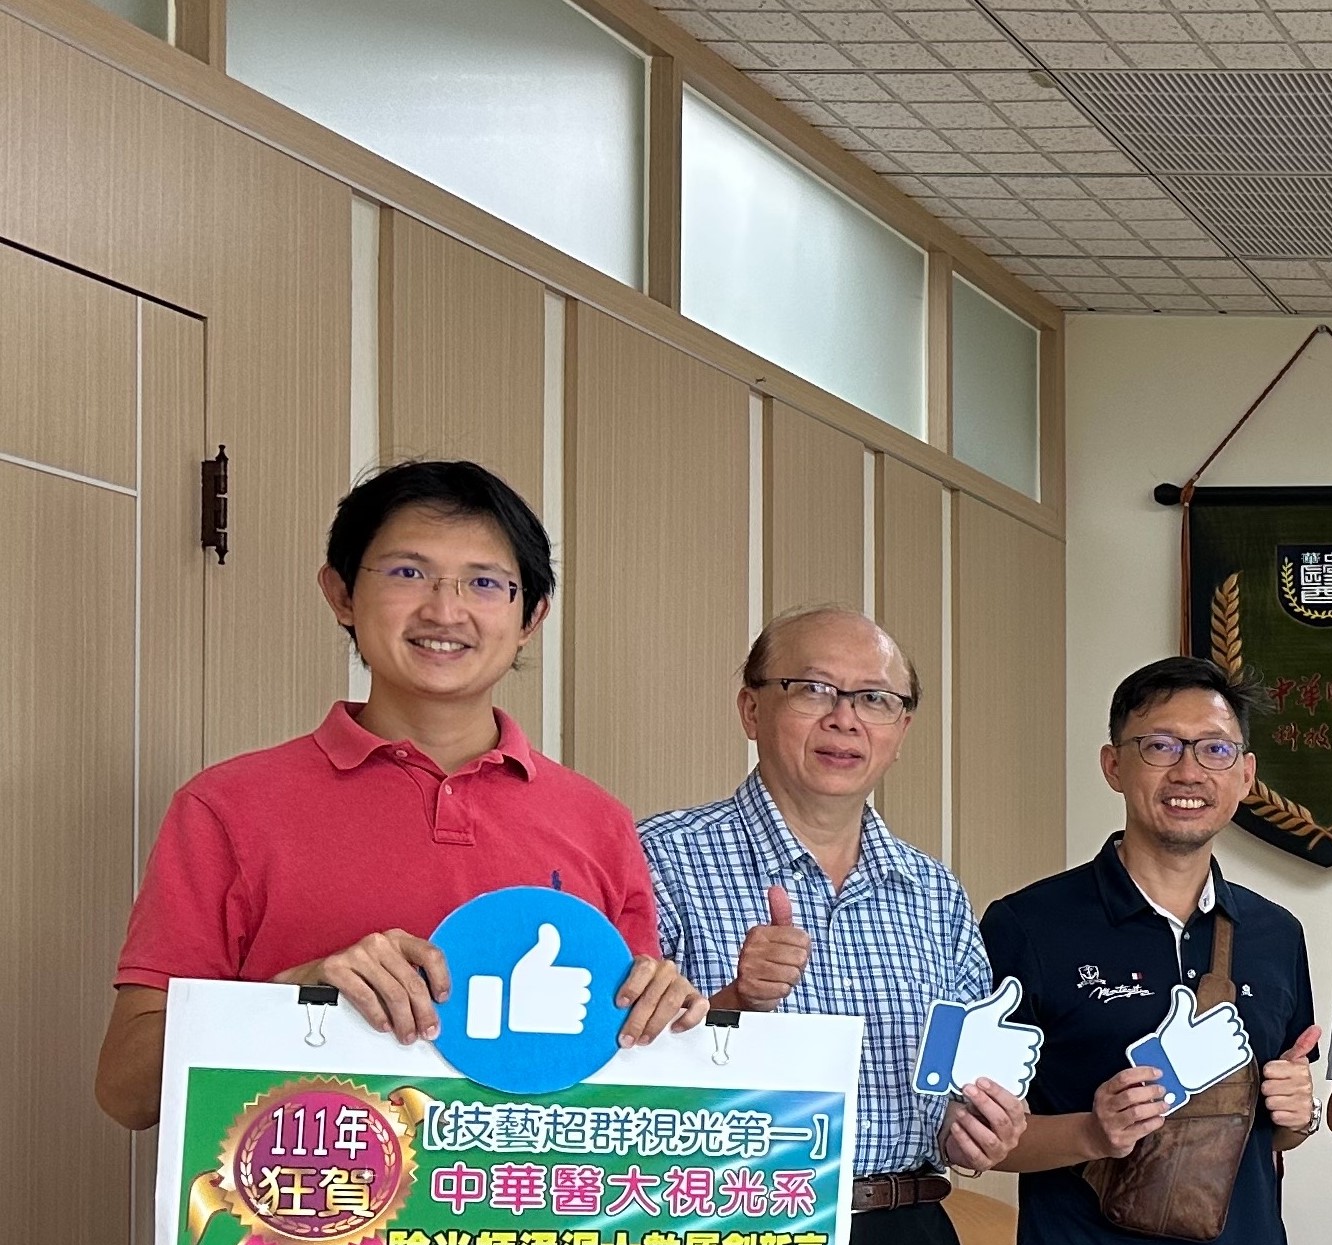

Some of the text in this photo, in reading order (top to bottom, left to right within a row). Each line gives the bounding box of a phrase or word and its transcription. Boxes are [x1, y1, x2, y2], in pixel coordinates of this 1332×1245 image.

[269, 1105, 368, 1157] 111年
[258, 1168, 377, 1220] 狂賀
[432, 1166, 817, 1217] 中華醫大視光系
